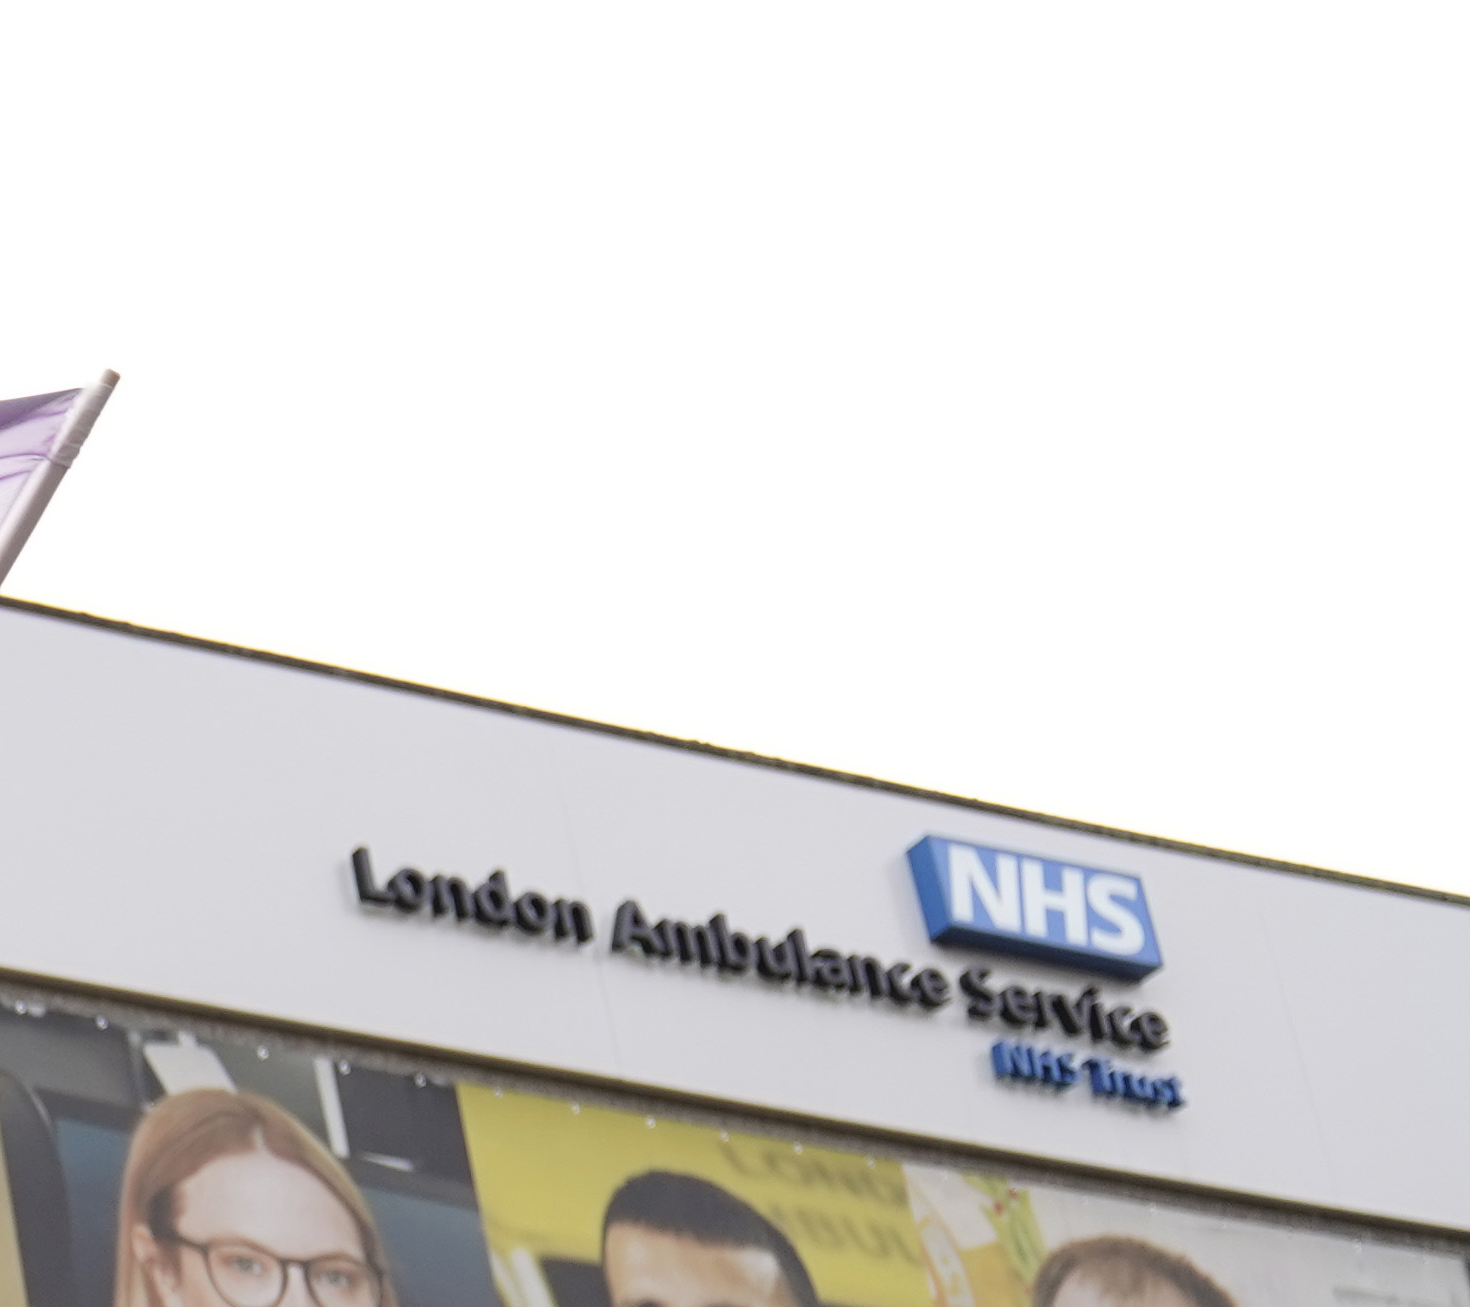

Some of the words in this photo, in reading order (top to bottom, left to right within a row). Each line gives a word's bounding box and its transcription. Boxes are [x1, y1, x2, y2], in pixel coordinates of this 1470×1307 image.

[351, 847, 595, 945] London
[610, 898, 951, 1010] Ambulance
[960, 965, 1171, 1053] Service
[947, 846, 1145, 956] NHS
[991, 1041, 1078, 1087] NHS
[1083, 1057, 1186, 1109] Trust
